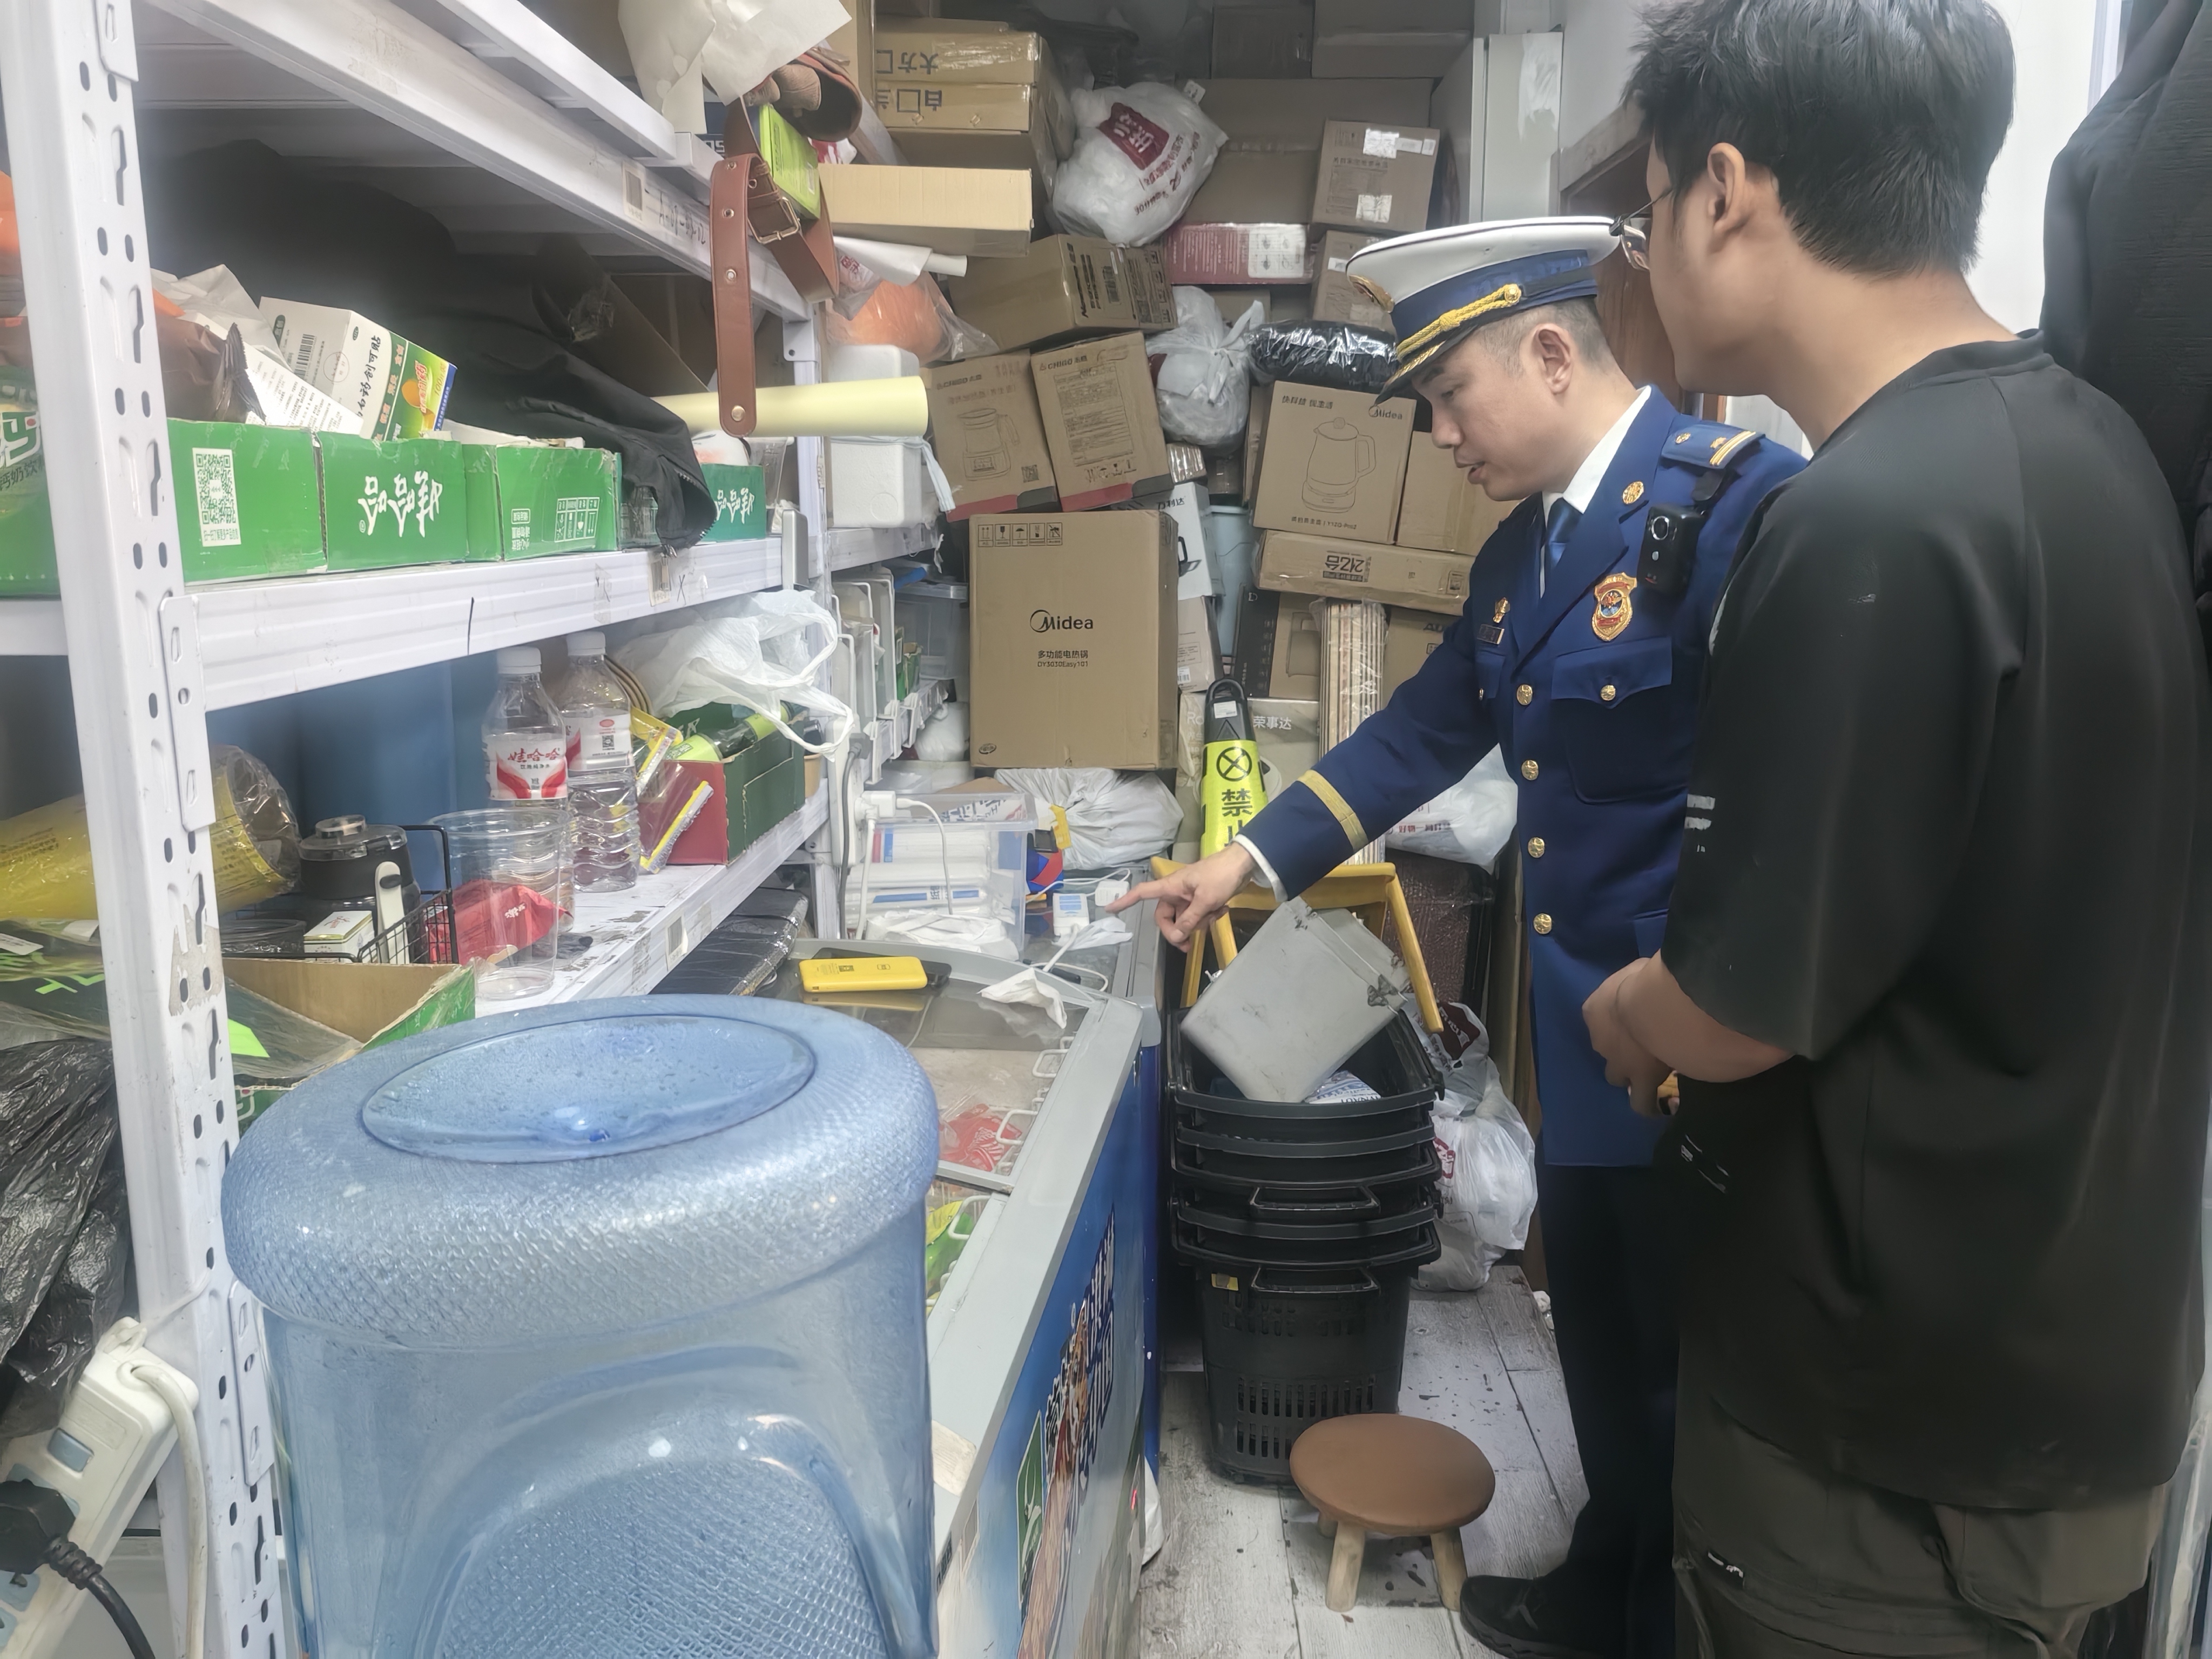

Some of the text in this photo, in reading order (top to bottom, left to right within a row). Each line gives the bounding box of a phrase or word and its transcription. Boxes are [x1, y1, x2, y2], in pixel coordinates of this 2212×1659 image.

[358, 470, 443, 537] 娃哈哈
[1325, 555, 1365, 573] 2亿台
[1030, 609, 1094, 632] Midea
[1038, 650, 1088, 659] 多功能电热锅
[1253, 716, 1292, 730] 荣事达
[508, 747, 559, 763] 娃哈哈
